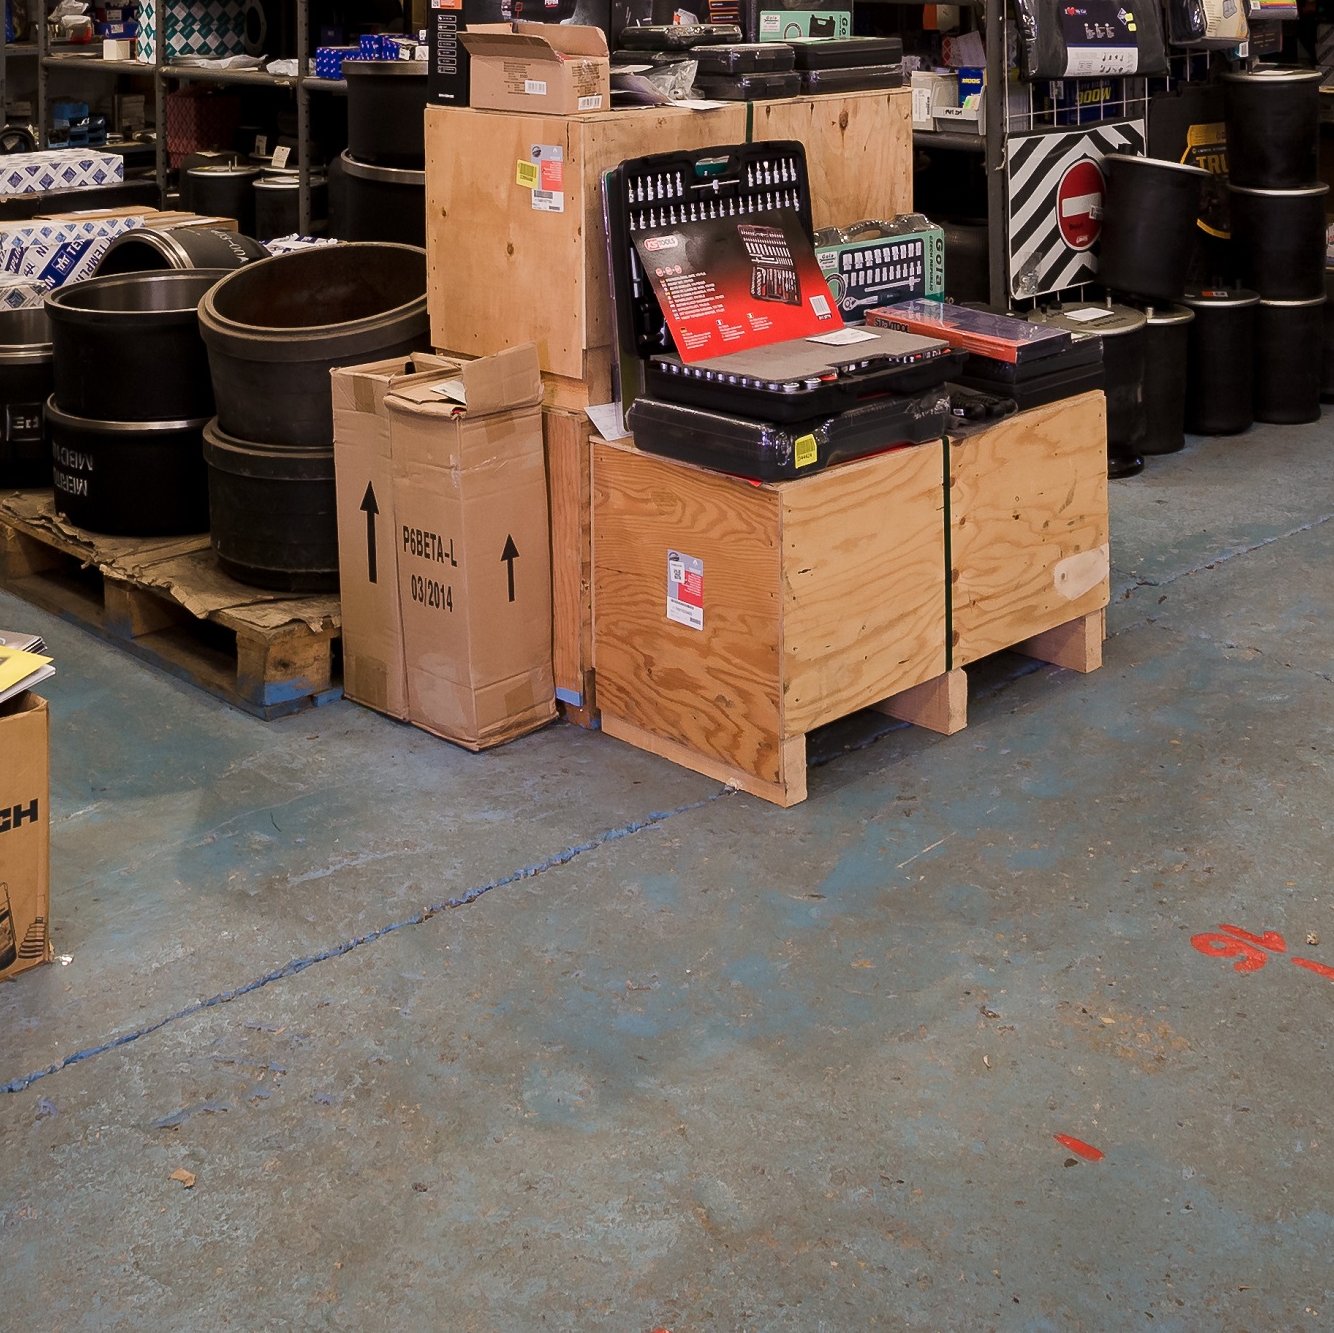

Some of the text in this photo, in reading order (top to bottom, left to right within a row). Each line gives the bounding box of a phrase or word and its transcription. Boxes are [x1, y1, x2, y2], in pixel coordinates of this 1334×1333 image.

[934, 237, 945, 287] Gola
[402, 525, 458, 568] P6BETA-L
[410, 576, 454, 614] 03/2014
